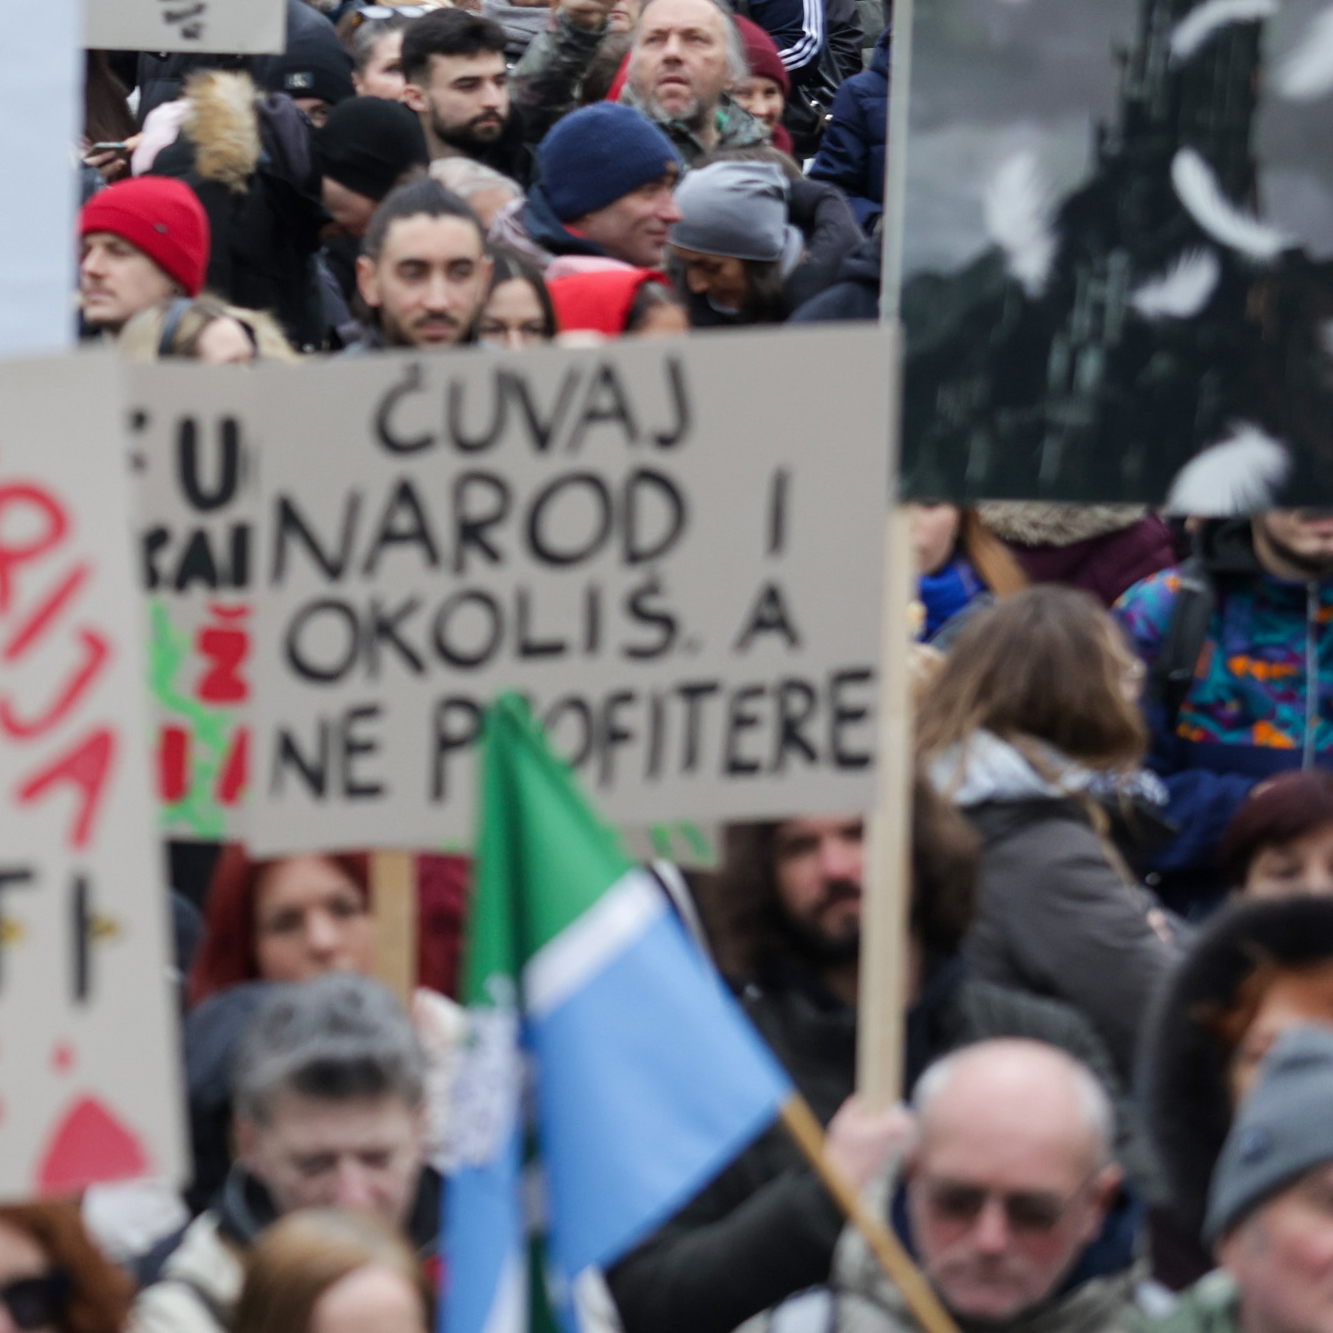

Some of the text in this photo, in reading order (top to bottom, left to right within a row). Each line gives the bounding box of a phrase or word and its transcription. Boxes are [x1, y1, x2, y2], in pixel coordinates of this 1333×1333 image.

[270, 467, 789, 587] NAROD I
[735, 580, 801, 651] A
[270, 704, 385, 800] NE
[430, 666, 874, 803] POFITERE
